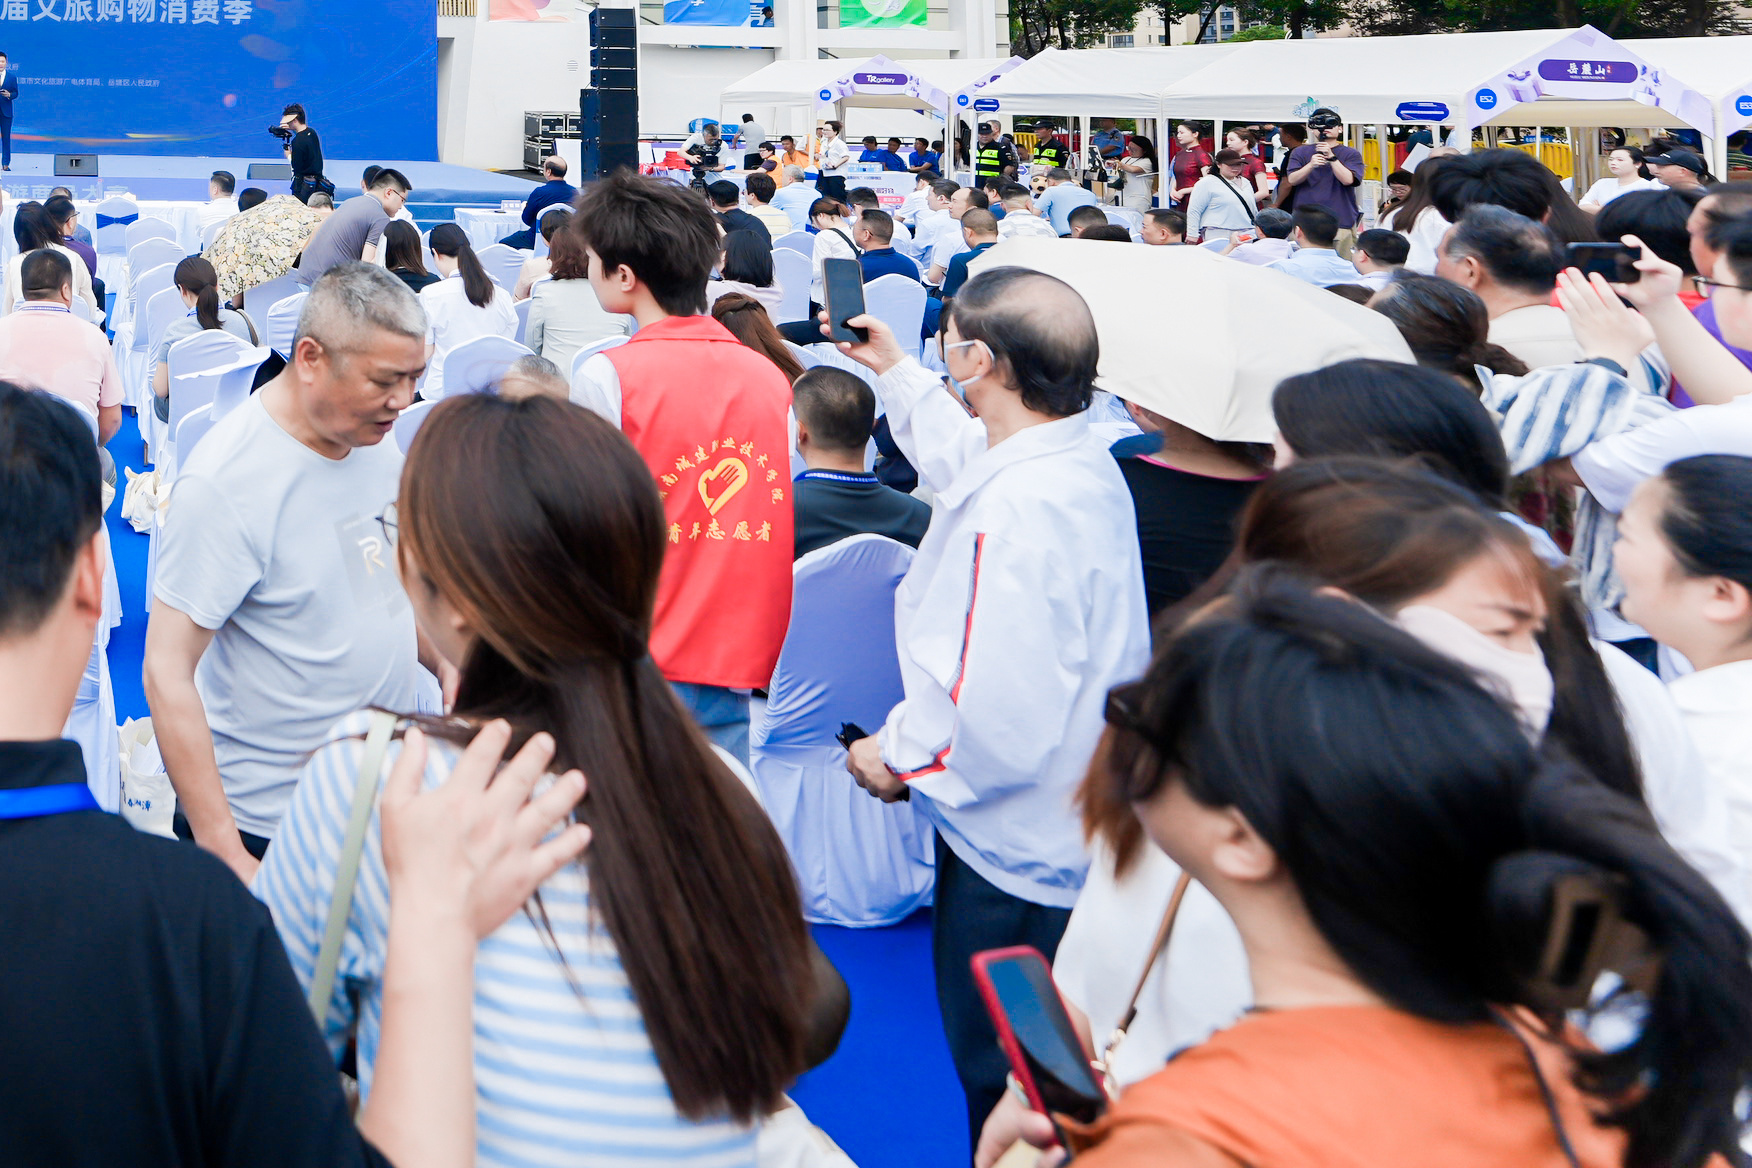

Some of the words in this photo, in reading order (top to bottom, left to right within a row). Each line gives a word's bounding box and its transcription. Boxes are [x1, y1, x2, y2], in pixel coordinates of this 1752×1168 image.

[1567, 62, 1606, 76] 岳麓山
[668, 518, 772, 544] 青年志愿者
